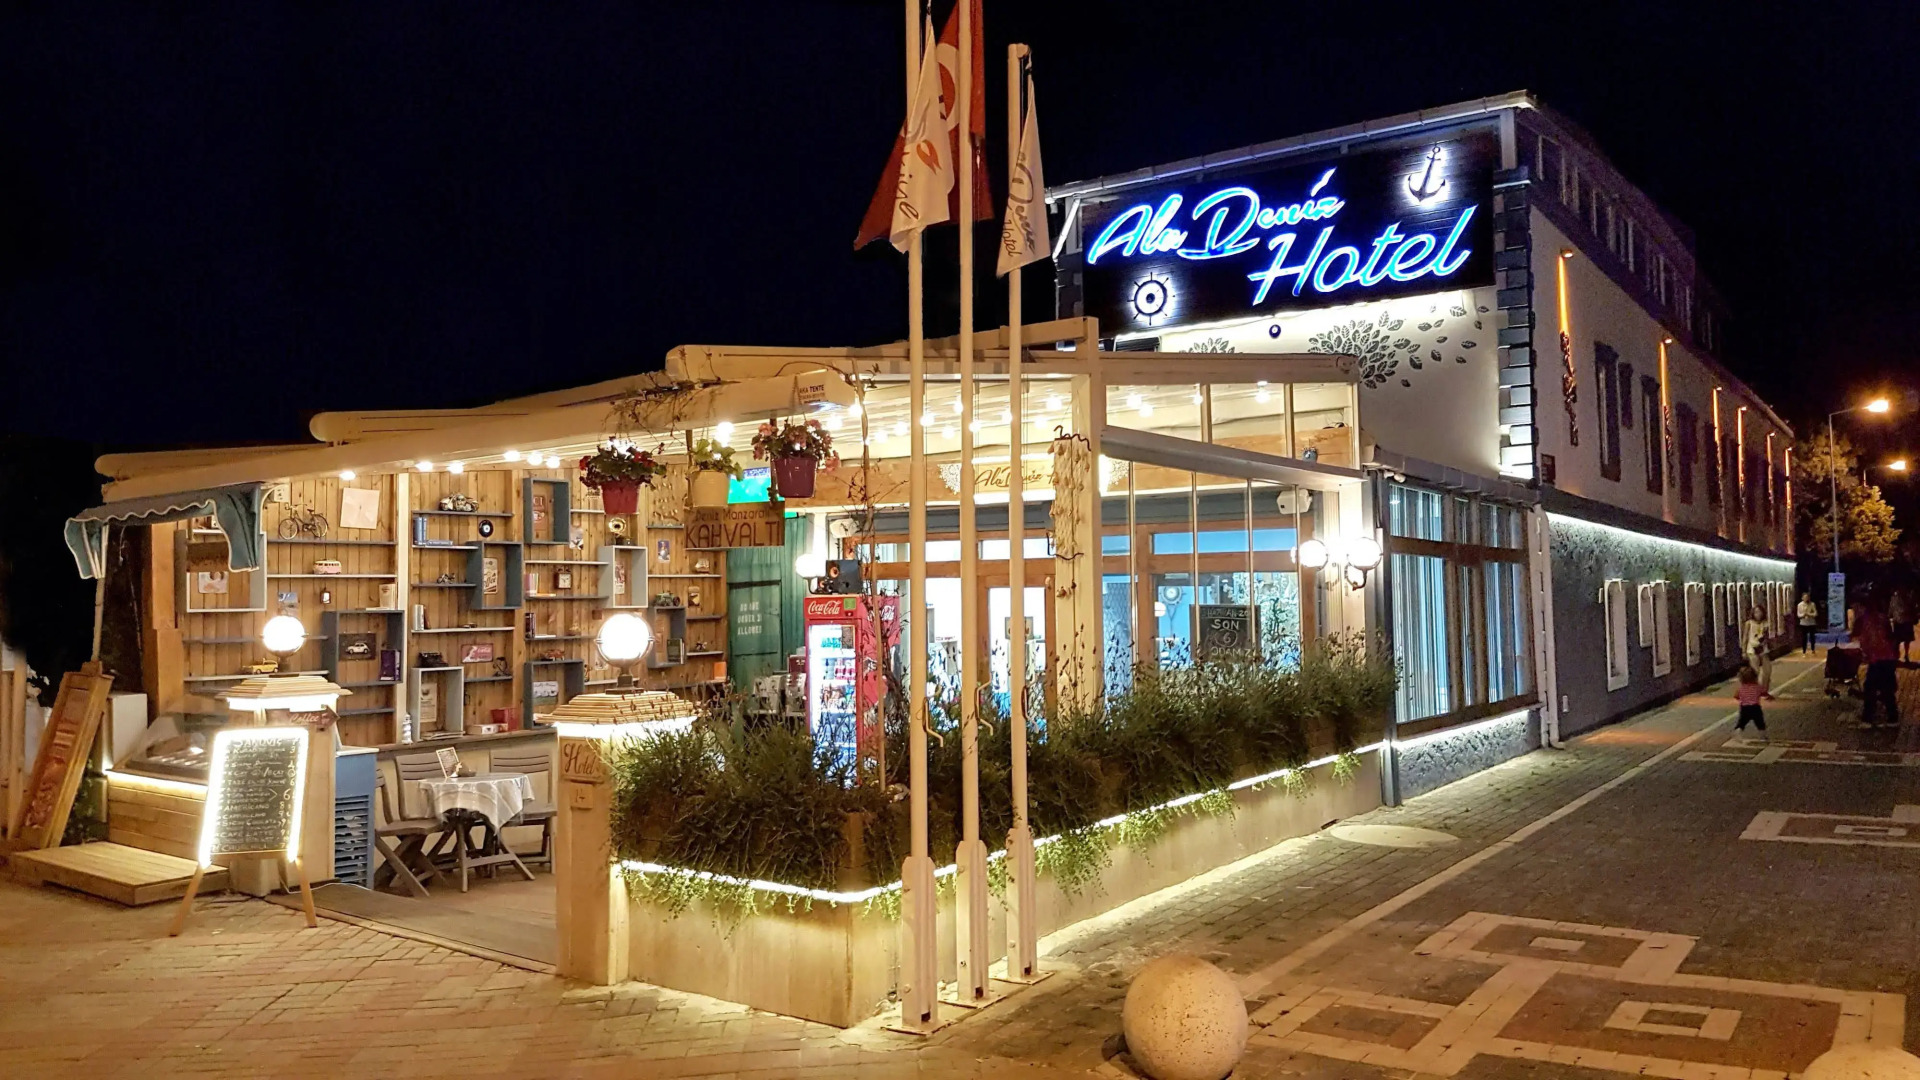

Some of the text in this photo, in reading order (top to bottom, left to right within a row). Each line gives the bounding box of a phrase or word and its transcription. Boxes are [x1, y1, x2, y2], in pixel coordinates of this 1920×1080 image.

[1087, 167, 1345, 265] Ala Deniz
[1248, 205, 1479, 306] Hotel
[974, 467, 1003, 486] Ala
[686, 521, 780, 548] KAHVALTI
[1211, 619, 1239, 630] SON
[1223, 632, 1231, 643] 6
[563, 743, 597, 775] Hotel
[283, 788, 291, 800] 6
